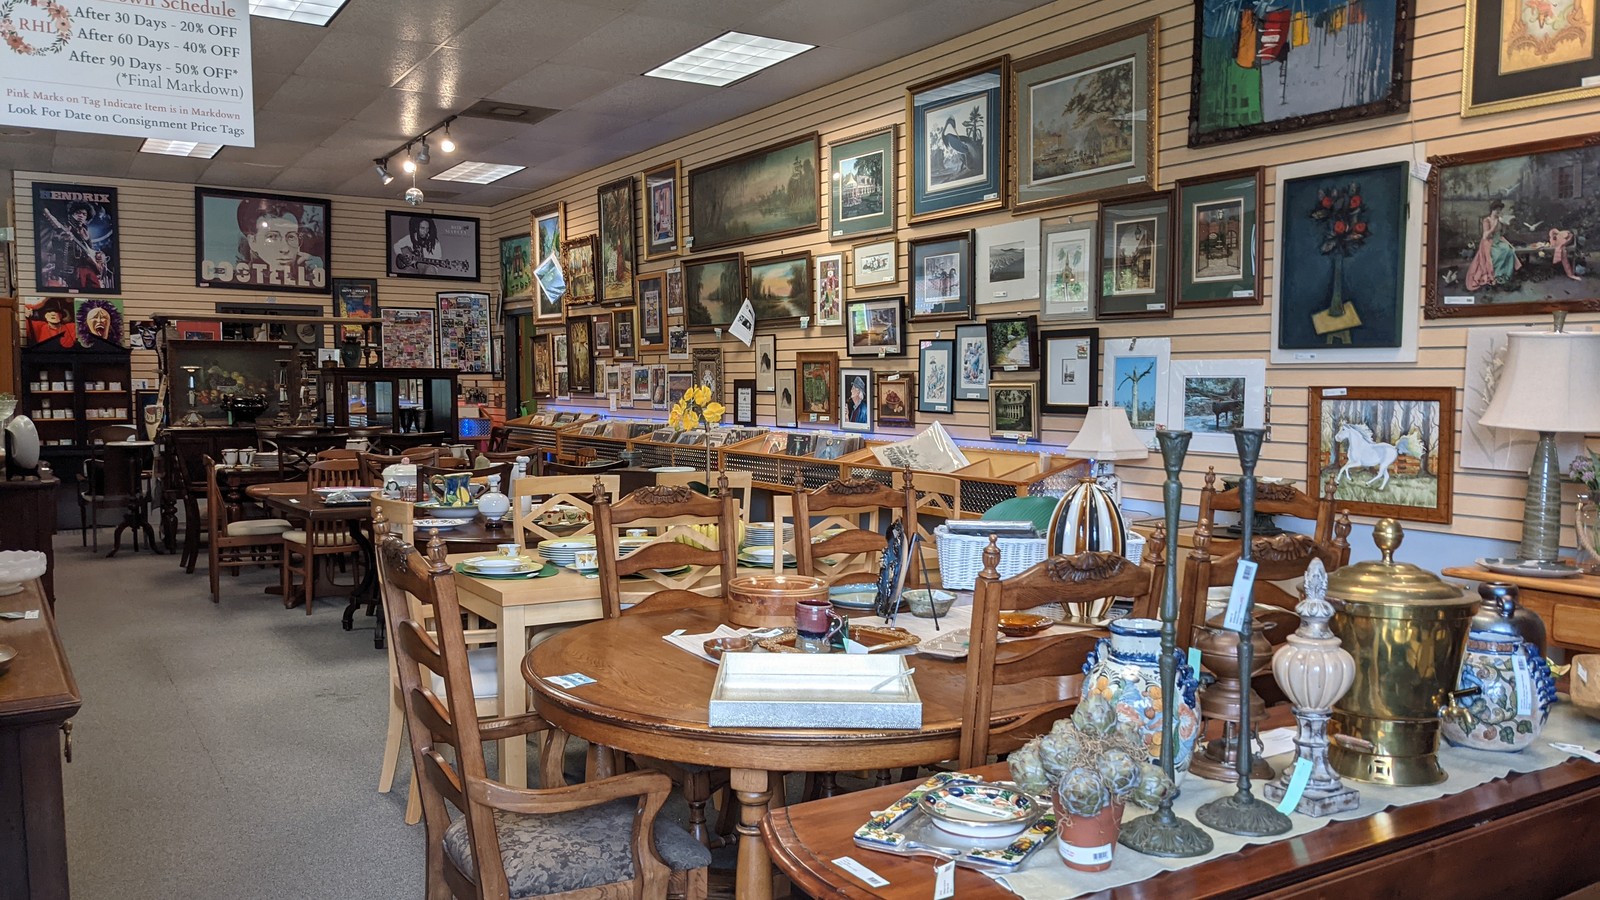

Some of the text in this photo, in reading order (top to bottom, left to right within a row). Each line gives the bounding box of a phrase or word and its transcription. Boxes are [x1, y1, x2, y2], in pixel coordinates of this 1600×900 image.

[74, 6, 111, 22] After
[115, 12, 130, 24] 30
[134, 15, 167, 30] Days
[180, 22, 204, 34] 20%
[208, 24, 238, 38] OFF
[161, 0, 236, 17] Schedule
[19, 17, 57, 34] RHL
[77, 28, 113, 44] After
[118, 34, 133, 45] 60
[137, 35, 170, 51] Days
[183, 42, 207, 55] 40%
[211, 45, 240, 58] OFF
[69, 51, 105, 66] After
[110, 55, 125, 67] 90
[130, 58, 162, 73] Days
[175, 64, 199, 76] 50%
[167, 78, 244, 99] Markdown)
[6, 88, 240, 120] Pink Marks on Tag Indicate Item is in Markdown
[8, 104, 245, 137] Look For Date on Consignment Price Tags
[39, 190, 110, 203] HENDRIX
[201, 259, 326, 288] COSTELLO
